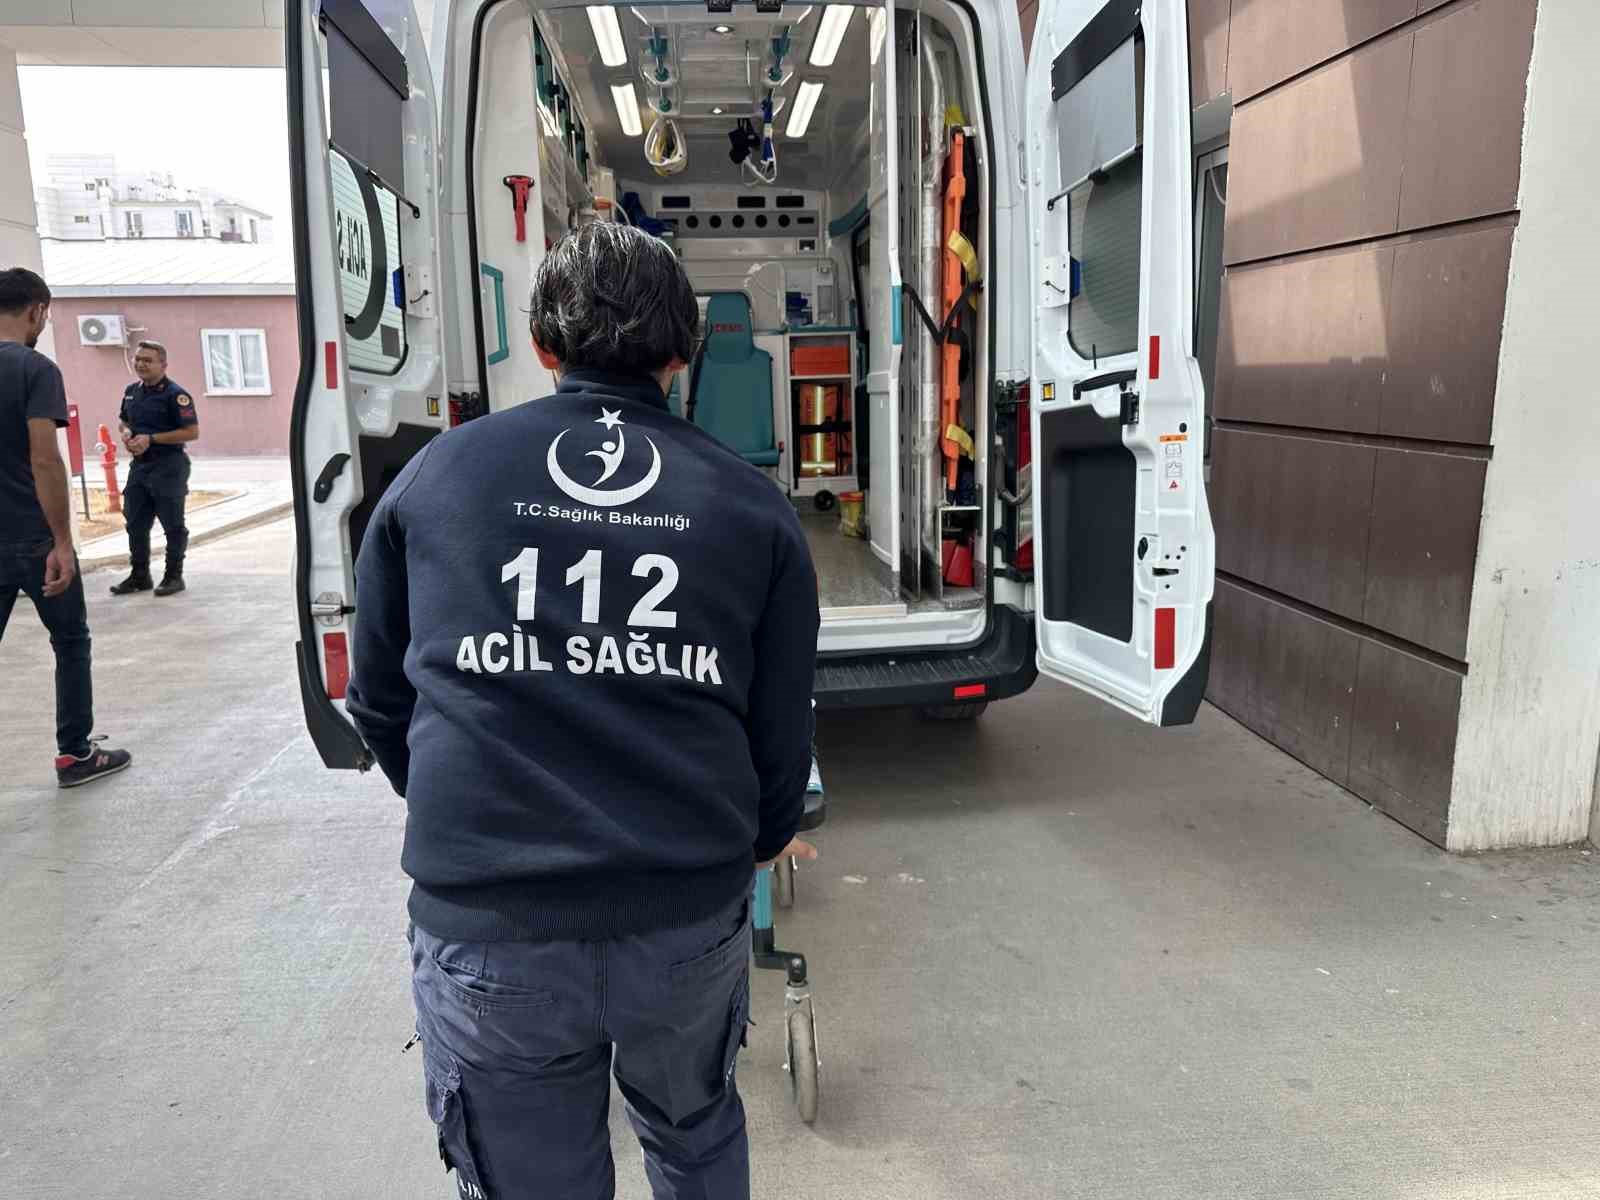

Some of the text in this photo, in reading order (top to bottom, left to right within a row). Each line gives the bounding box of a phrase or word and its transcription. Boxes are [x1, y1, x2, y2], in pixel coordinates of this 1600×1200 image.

[608, 511, 690, 531] Bakanlığı
[501, 547, 680, 628] 112
[456, 623, 723, 685] ACİL SAĞLIK
